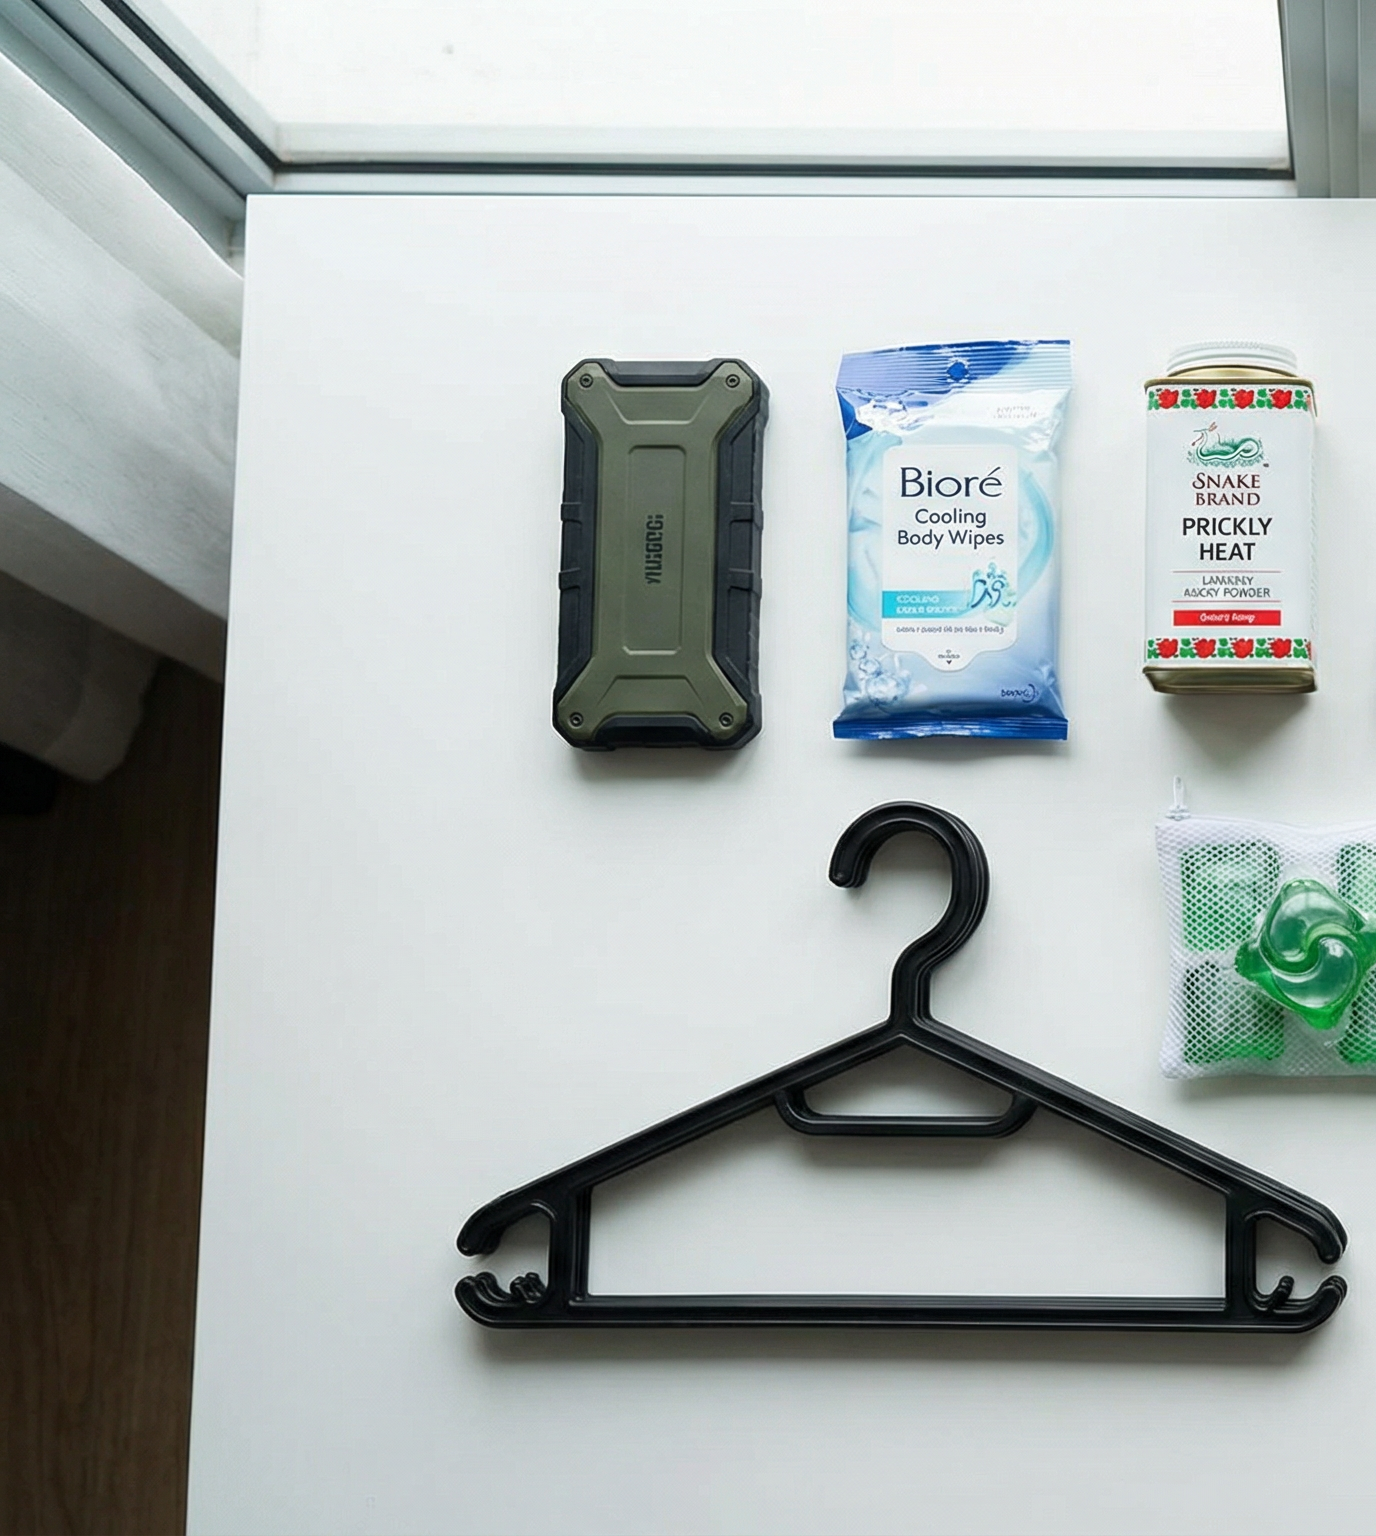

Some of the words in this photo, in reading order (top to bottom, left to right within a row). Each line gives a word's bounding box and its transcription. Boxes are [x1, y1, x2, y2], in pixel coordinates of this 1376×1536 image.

[900, 466, 1003, 498] Bioré
[1192, 472, 1261, 490] SNAKE
[1195, 492, 1261, 506] BRAND
[915, 508, 987, 529] Cooling
[1182, 517, 1273, 536] PRICKLY
[897, 529, 945, 550] Body
[948, 529, 1005, 550] Wipes
[1199, 542, 1256, 561] HEAT
